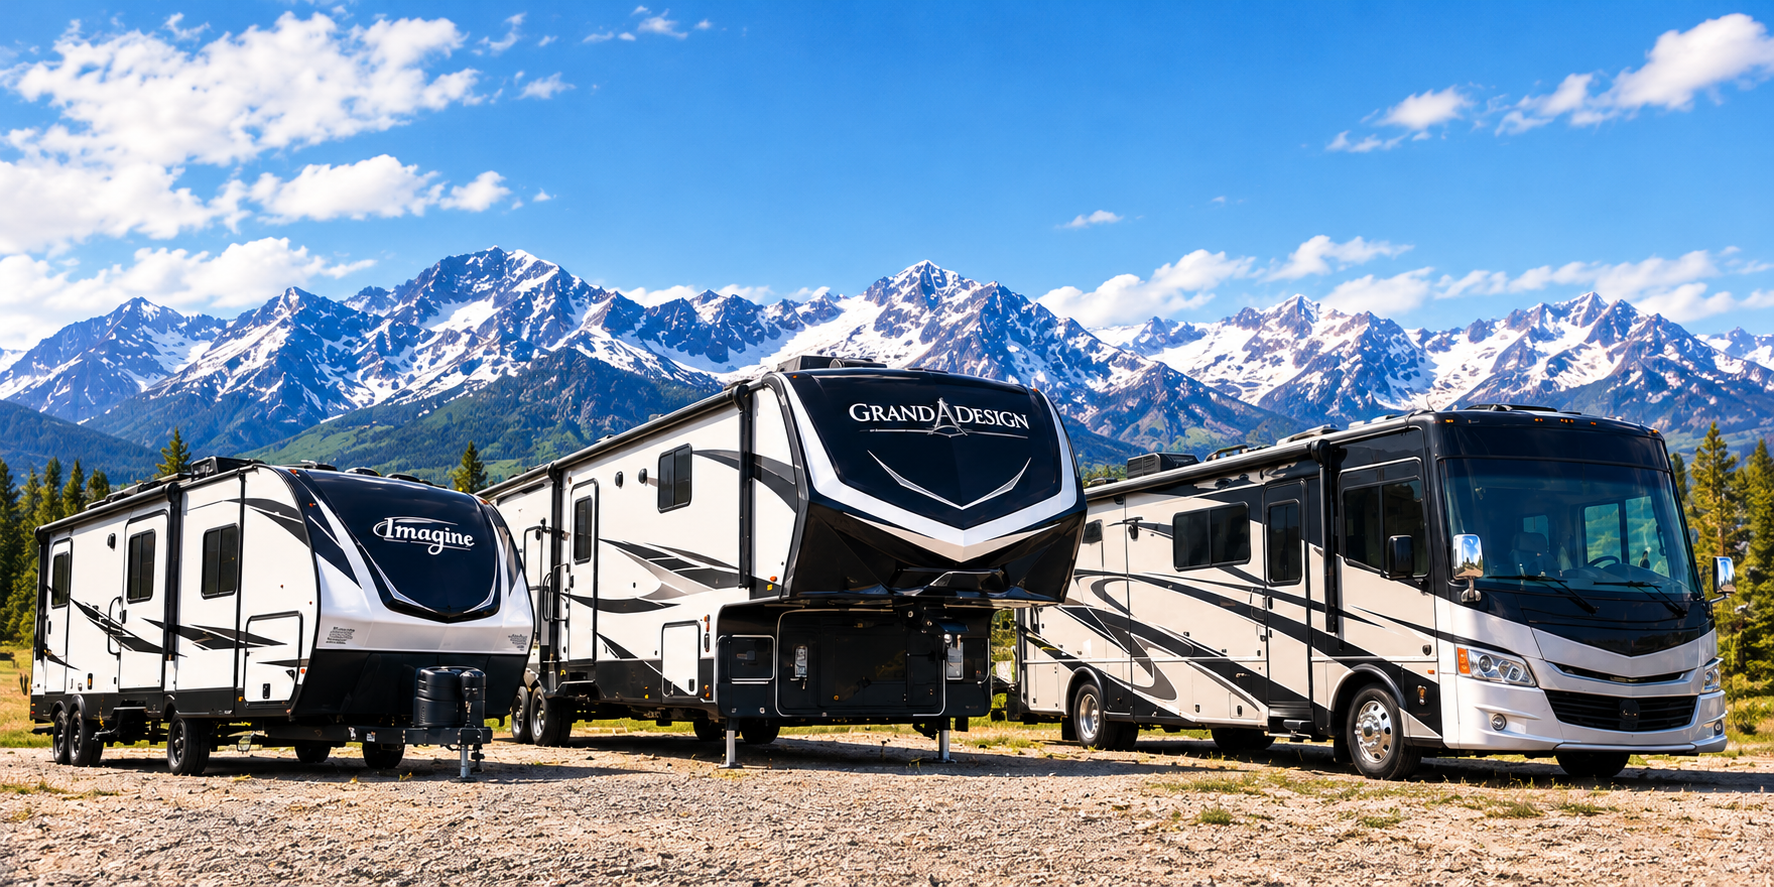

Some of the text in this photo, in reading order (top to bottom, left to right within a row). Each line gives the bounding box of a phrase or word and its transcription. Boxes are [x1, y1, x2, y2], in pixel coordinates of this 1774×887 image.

[849, 403, 1030, 430] GRAND DESIGN
[373, 517, 475, 555] Imagine
